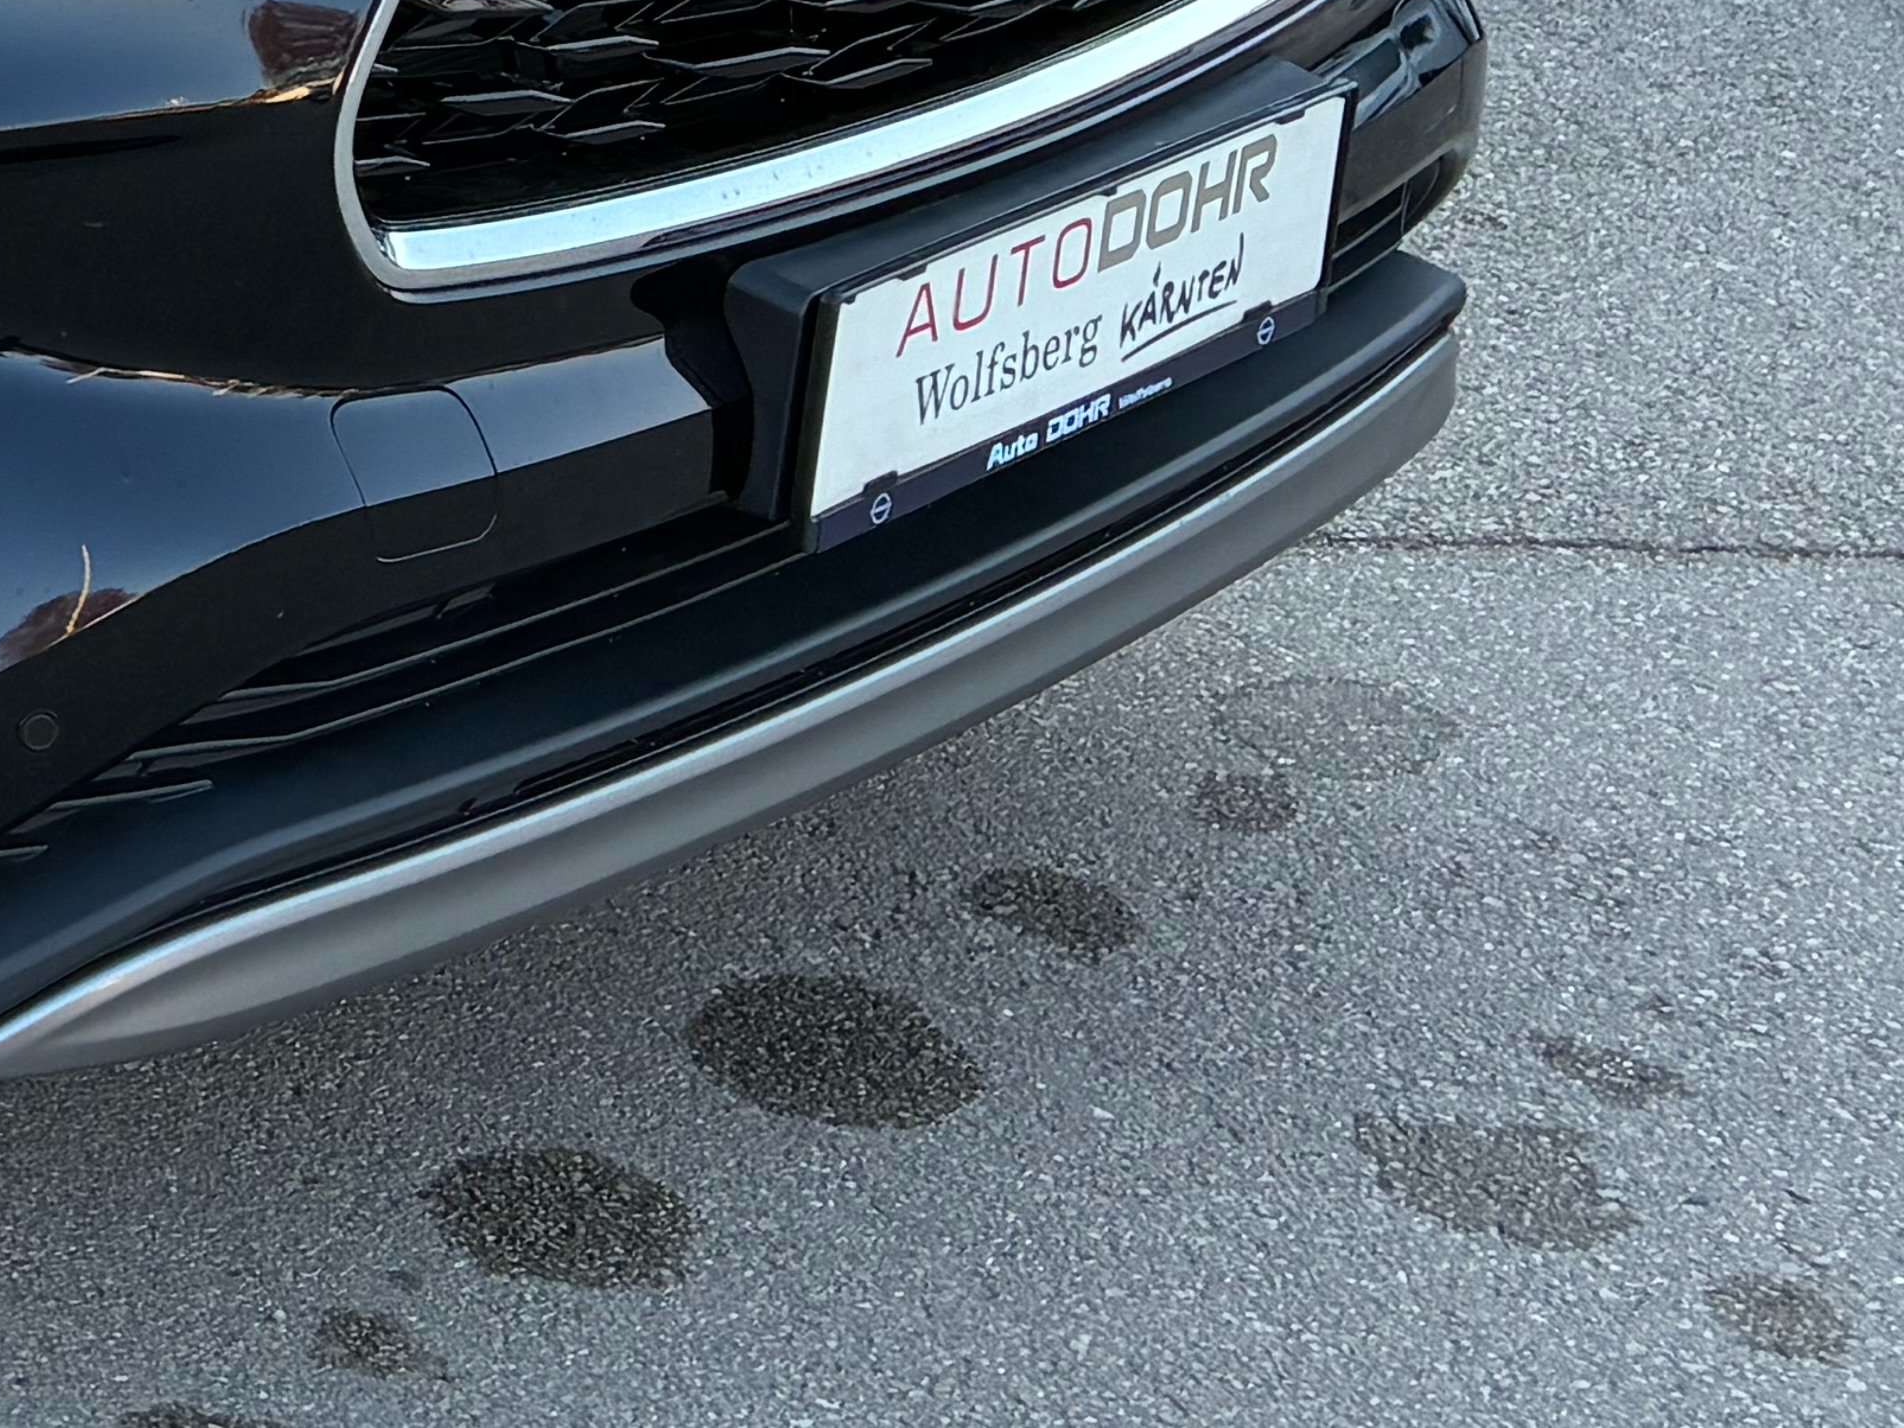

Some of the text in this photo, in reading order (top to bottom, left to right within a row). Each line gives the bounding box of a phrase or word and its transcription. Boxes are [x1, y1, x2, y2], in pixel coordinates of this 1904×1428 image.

[915, 313, 1103, 426] Wolfsberg
[986, 432, 1039, 472] Auto
[1046, 393, 1112, 444] DOHR
